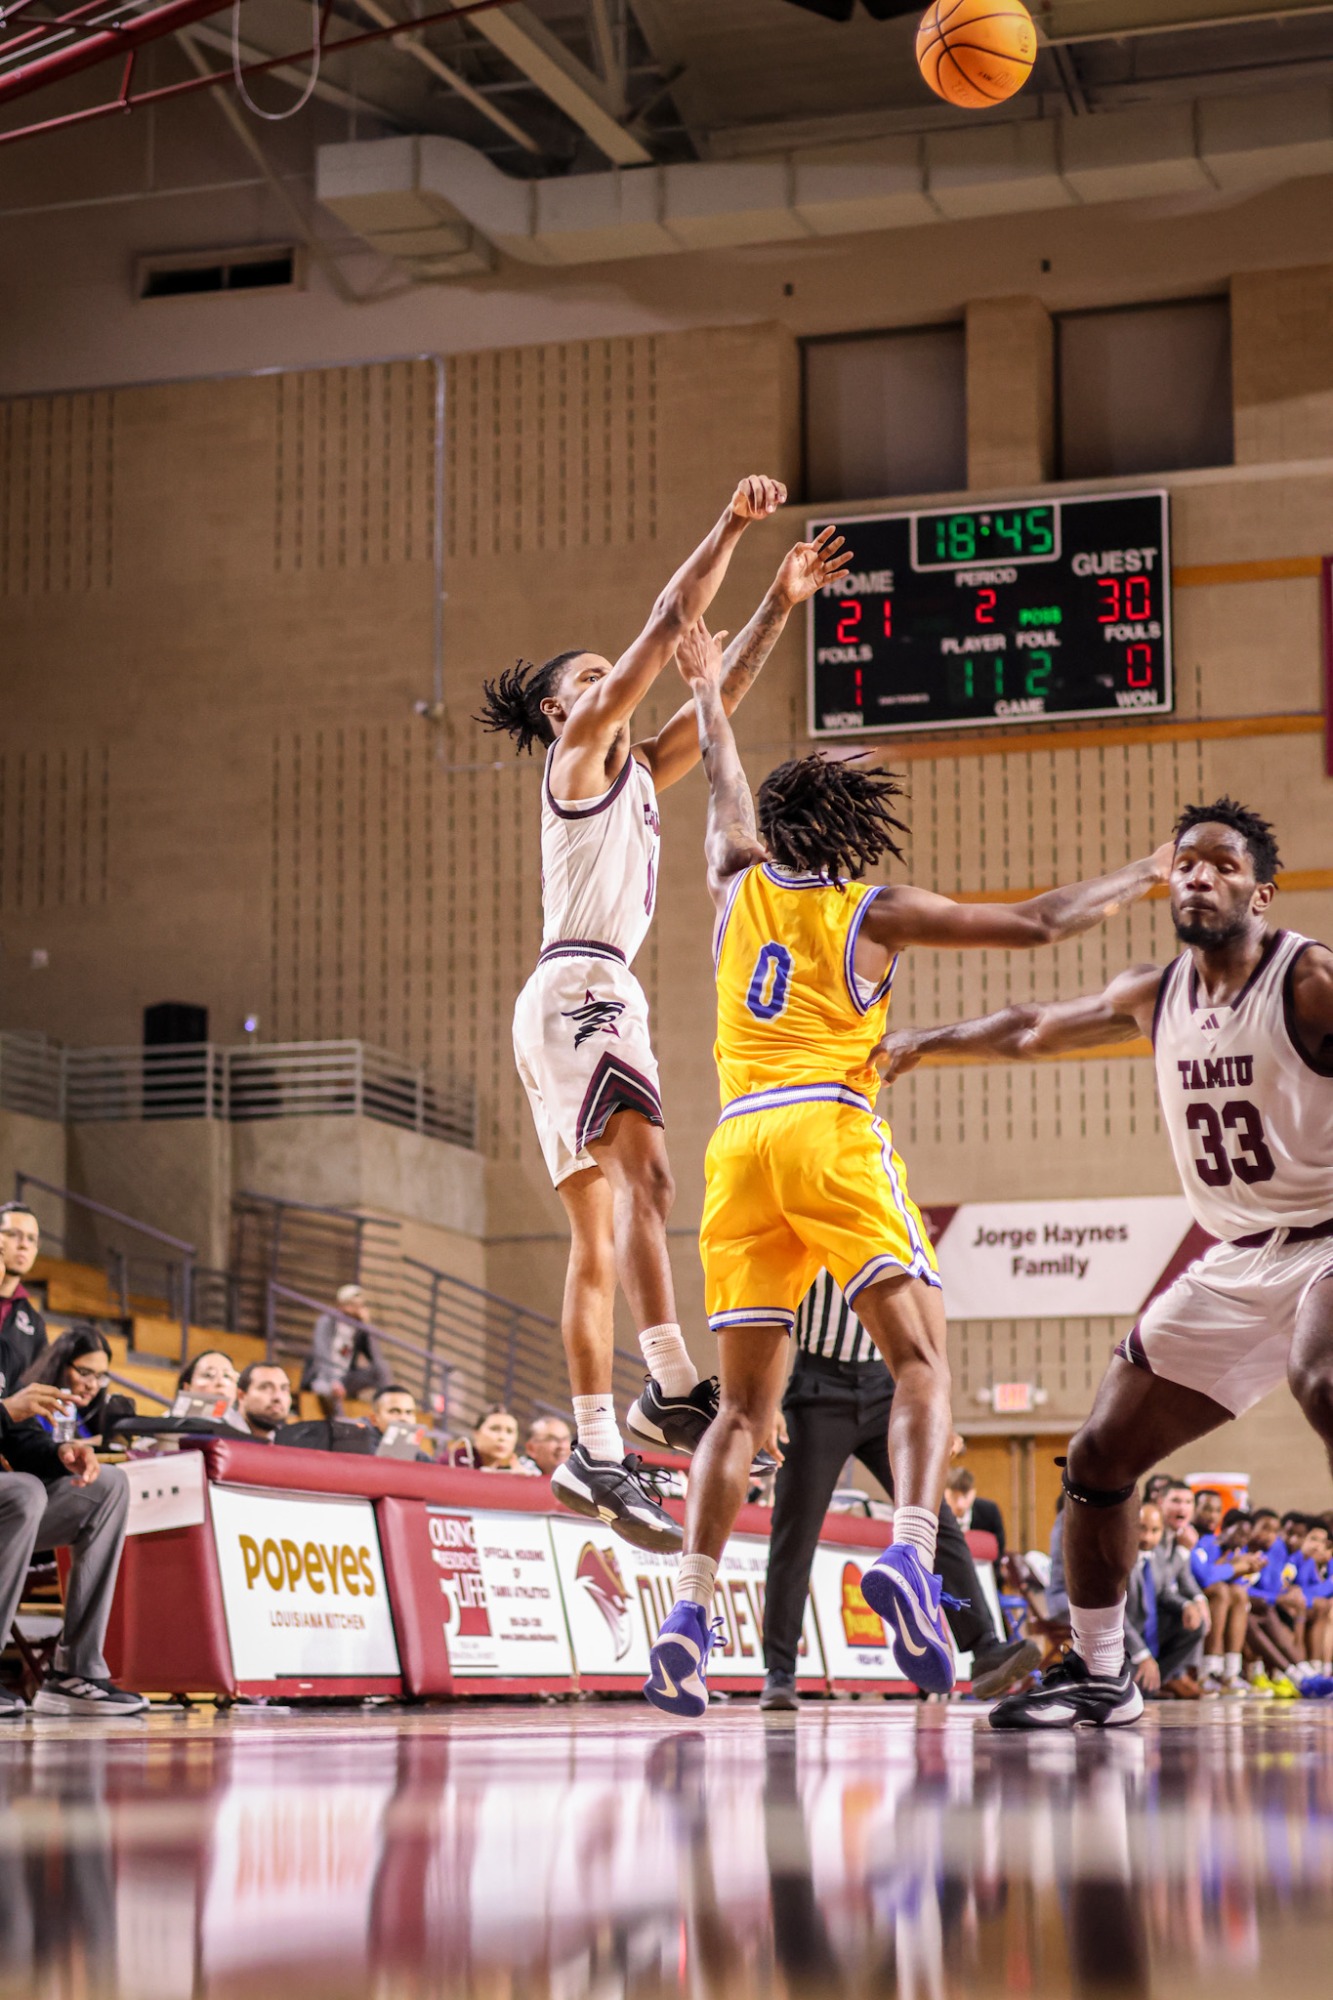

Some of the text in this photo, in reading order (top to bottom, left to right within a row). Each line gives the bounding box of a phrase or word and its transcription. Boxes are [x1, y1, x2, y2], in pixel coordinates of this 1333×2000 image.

[936, 508, 1052, 560] 18:45
[1072, 548, 1158, 576] GUEST
[823, 570, 895, 597] HOME
[955, 566, 1018, 587] PERIOD
[975, 588, 997, 623] 2
[1097, 576, 1150, 623] 30
[941, 630, 1061, 655] PLAYER FOUL
[1104, 621, 1161, 642] FOULS
[818, 644, 873, 664] FOULS
[1127, 644, 1152, 687] 0
[855, 668, 862, 706] 1
[1115, 689, 1158, 708] WON
[822, 711, 864, 728] WON
[994, 697, 1045, 716] GAME
[745, 940, 795, 1023] 0
[1177, 1055, 1253, 1089] TAMIU
[1186, 1100, 1276, 1186] 33
[973, 1224, 1128, 1249] Jorge Haynes
[1012, 1255, 1089, 1277] Family
[453, 1573, 487, 1608] LIFE
[270, 1610, 366, 1630] LOUISIANA KITCHEN
